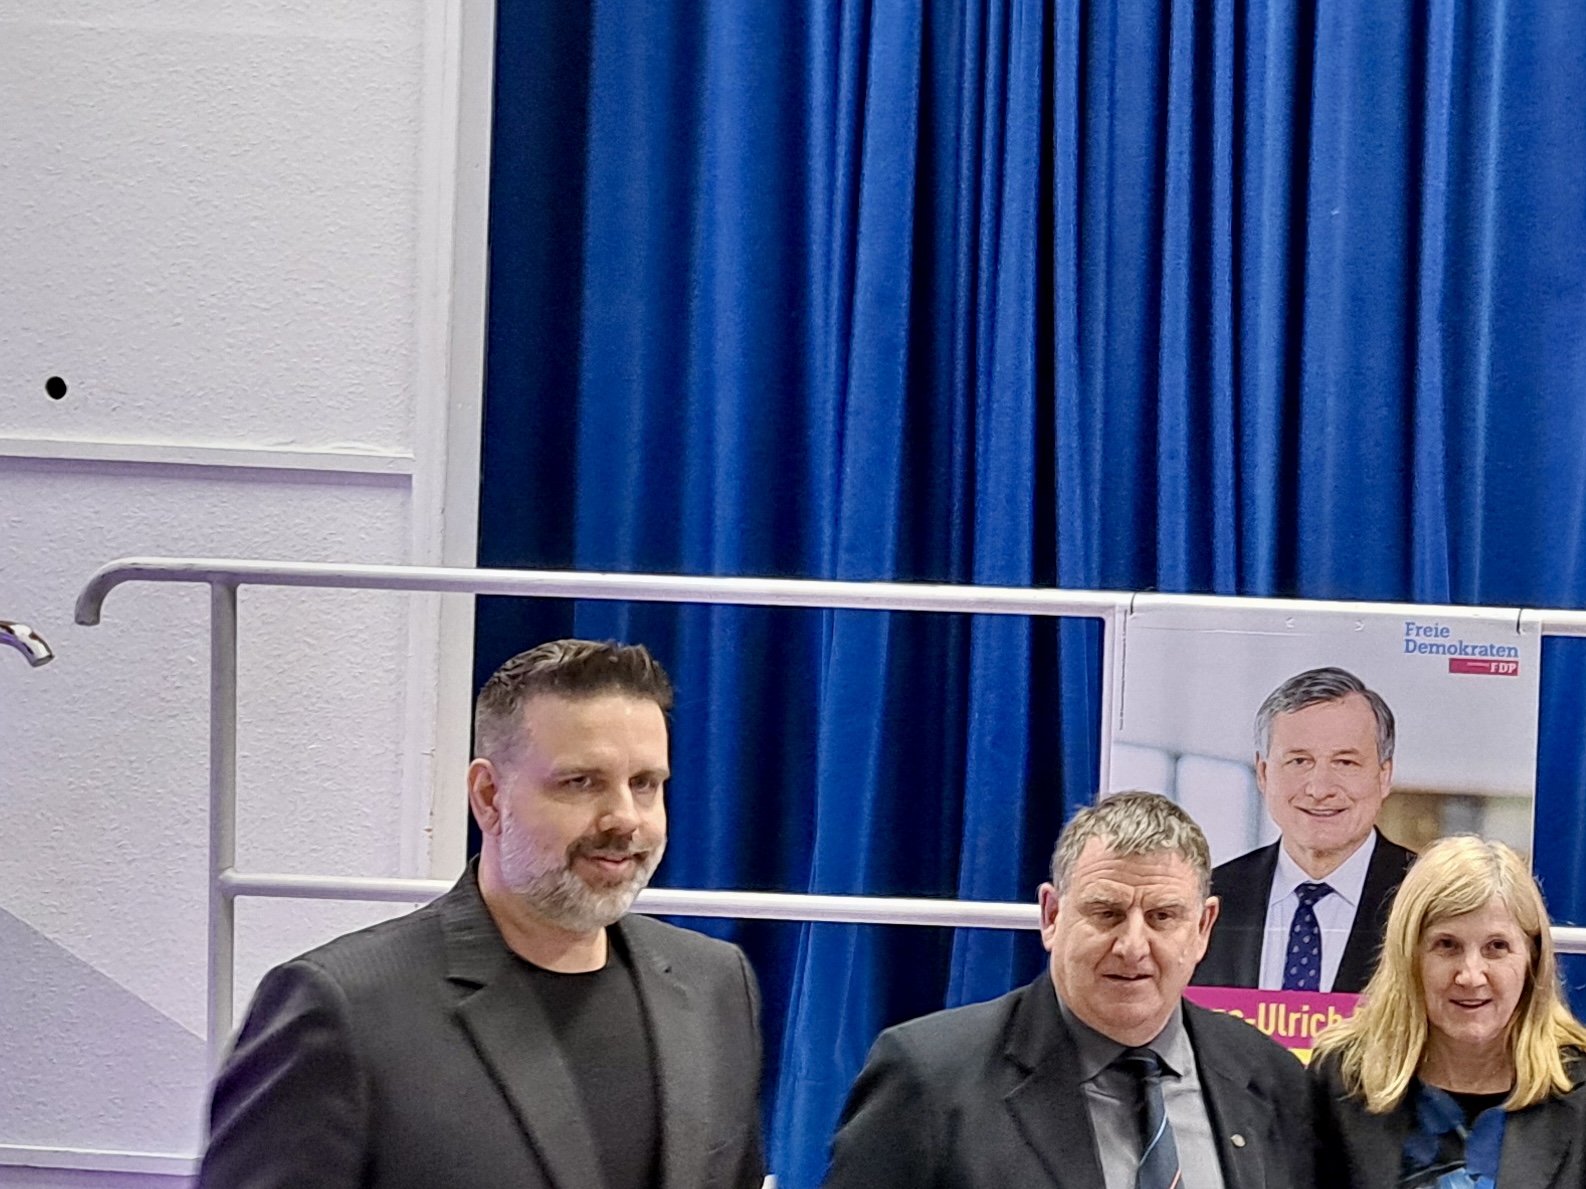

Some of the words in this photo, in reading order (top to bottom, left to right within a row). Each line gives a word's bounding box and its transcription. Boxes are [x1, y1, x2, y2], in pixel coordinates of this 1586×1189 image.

[1405, 622, 1450, 638] Freie
[1404, 639, 1519, 657] Demokraten
[1490, 662, 1517, 674] FDP
